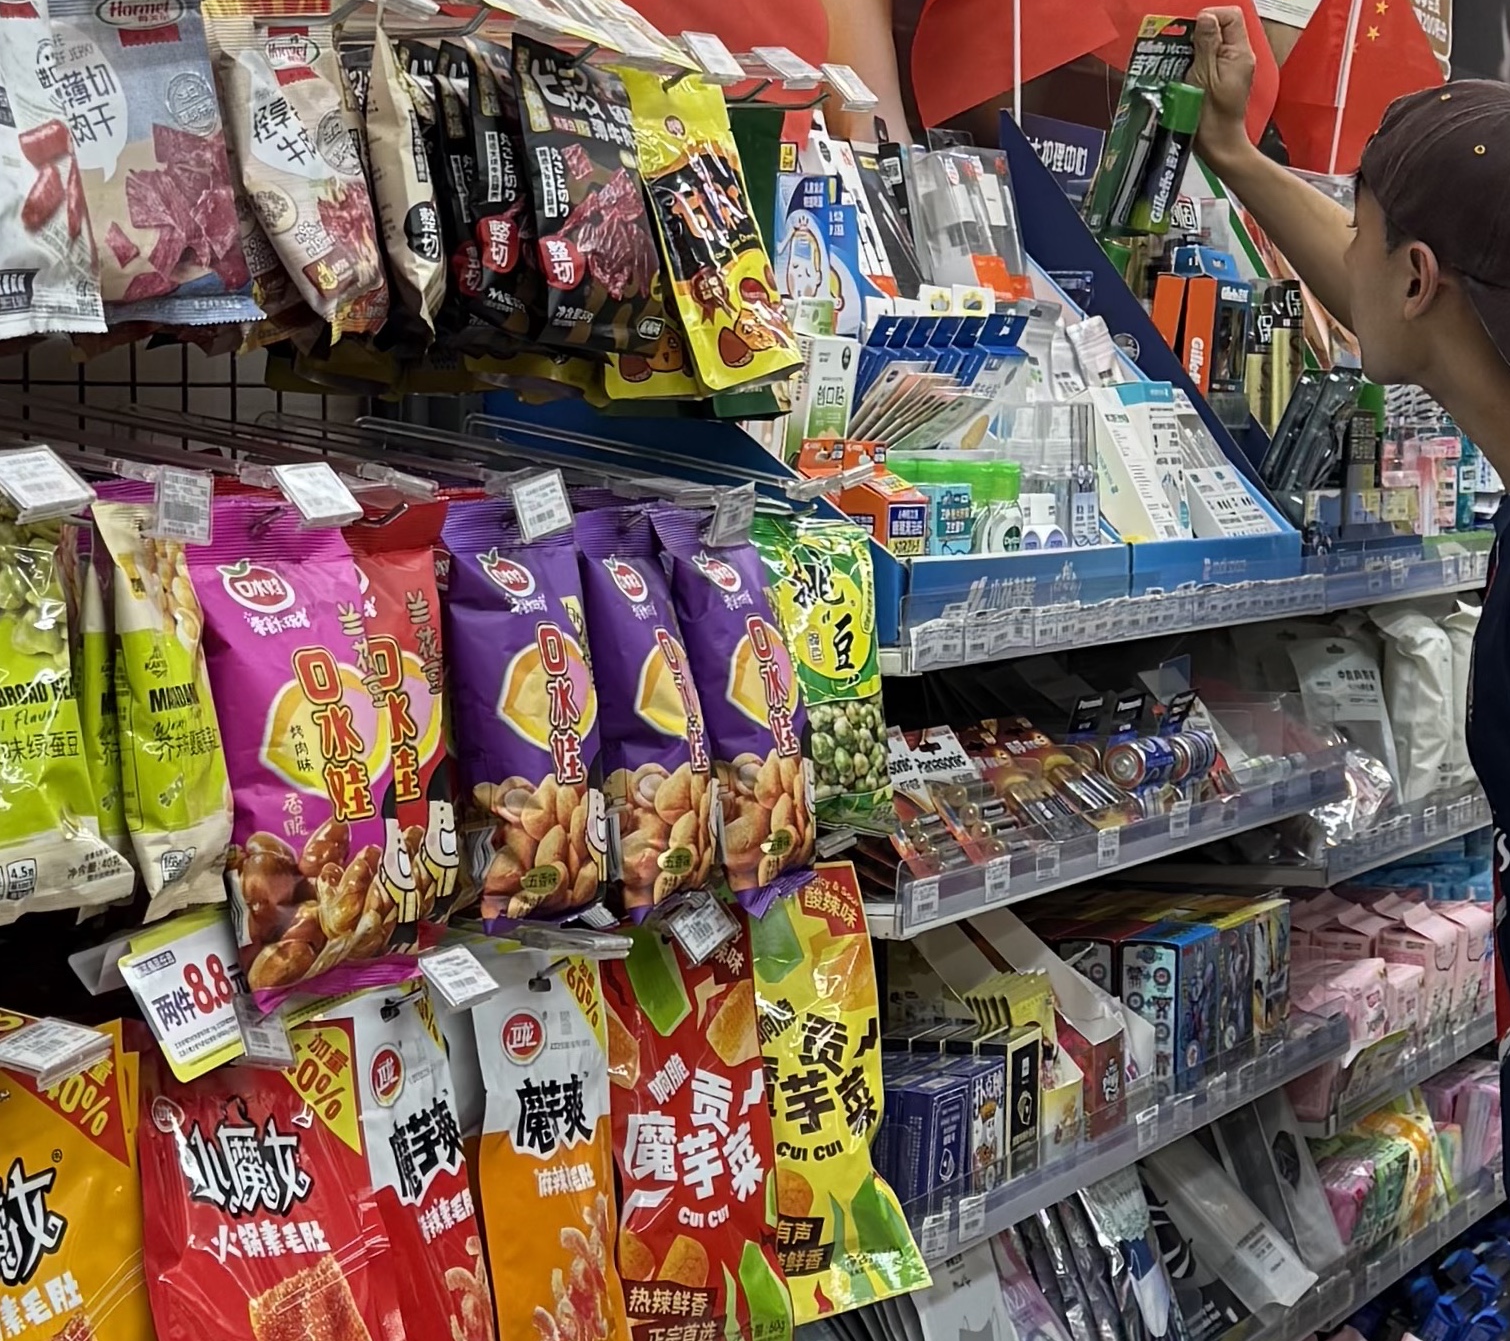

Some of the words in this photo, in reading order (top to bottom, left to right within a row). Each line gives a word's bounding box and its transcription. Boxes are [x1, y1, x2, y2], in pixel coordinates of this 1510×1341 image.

[62, 63, 118, 109] 薄切
[70, 104, 118, 147] 肉干
[234, 577, 285, 599] 口水娃
[536, 621, 584, 785] 口水娃
[746, 614, 800, 757] 口水娃
[293, 646, 377, 823] 口水娃
[916, 754, 968, 775] Panasonic
[803, 886, 860, 929] 酸辣味
[515, 1075, 592, 1157] 魔芋爽
[776, 1140, 809, 1162] CUI
[813, 1138, 845, 1161] CUI
[677, 1205, 705, 1228] CUI
[210, 1220, 332, 1262] 火锅素毛肚
[628, 1285, 709, 1318] 热辣鲜香
